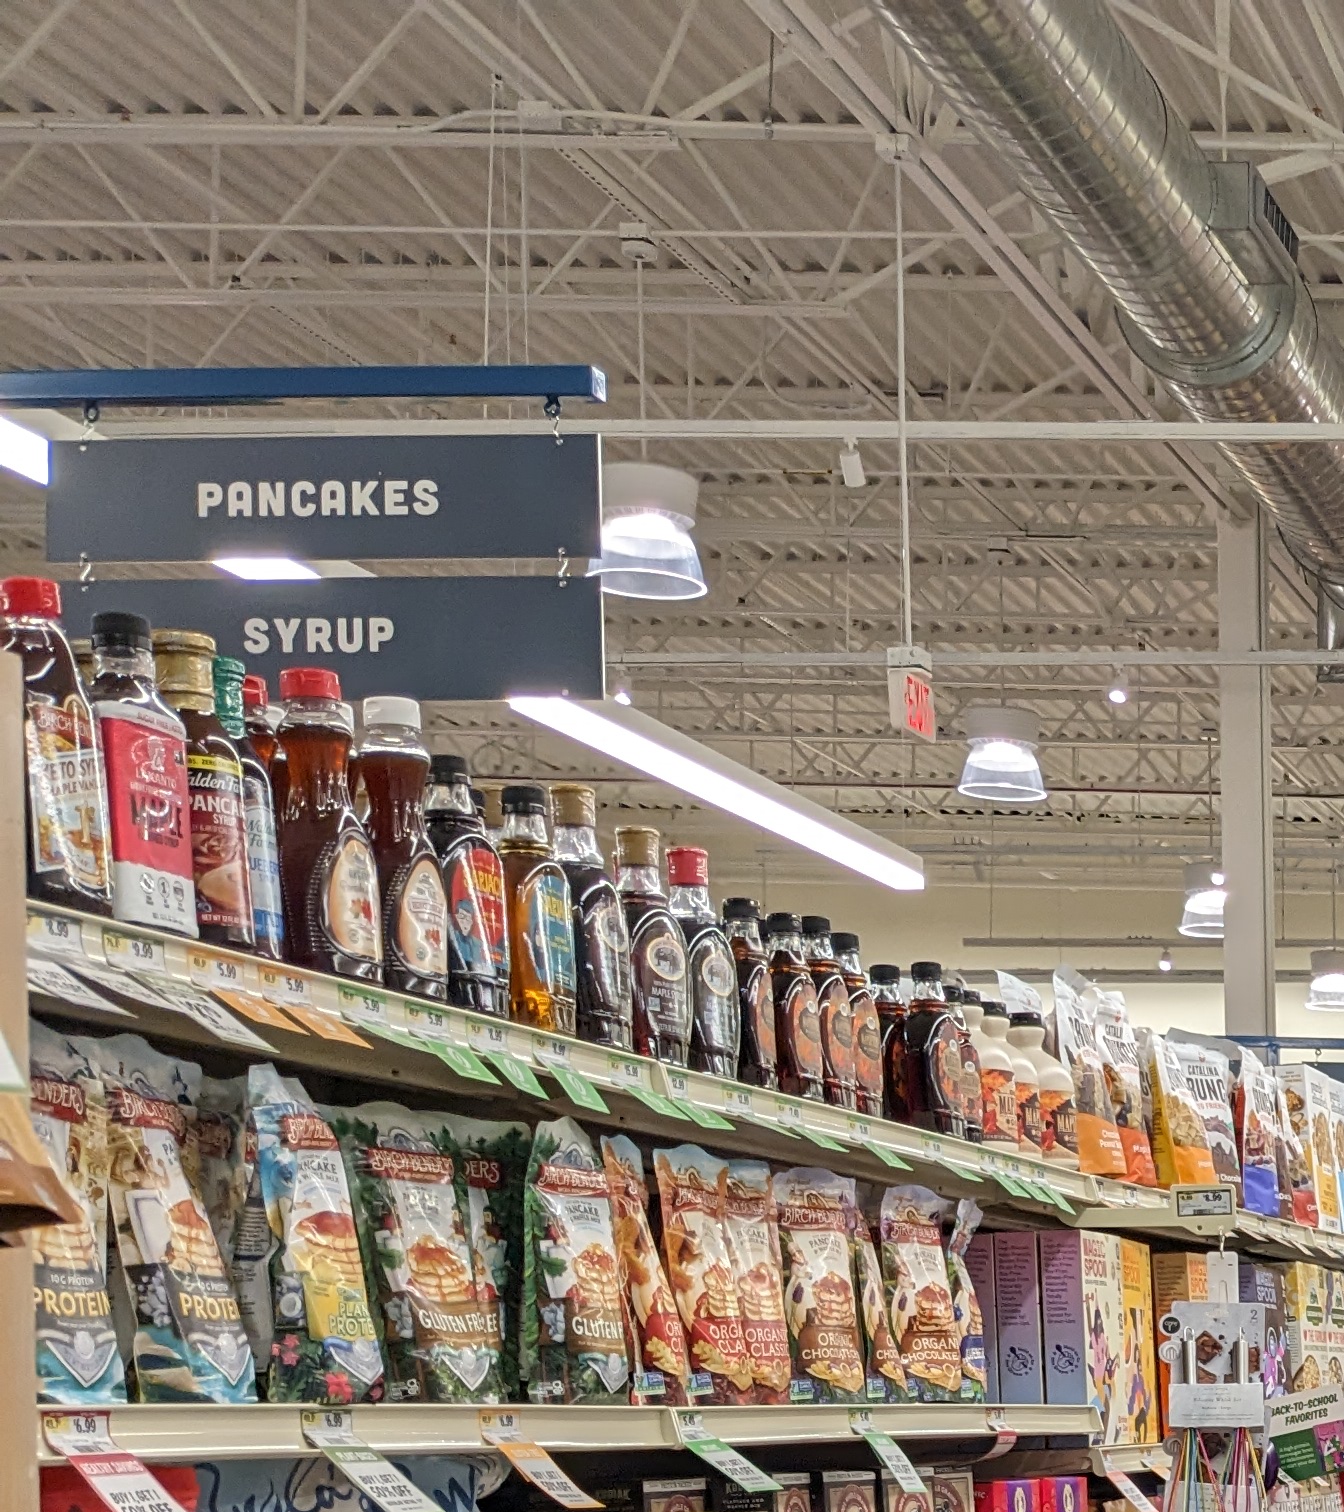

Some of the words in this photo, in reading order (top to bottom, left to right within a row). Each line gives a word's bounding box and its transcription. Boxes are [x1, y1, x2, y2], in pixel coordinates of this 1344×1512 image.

[197, 479, 439, 518] PANCAKES
[243, 617, 396, 654] SYRUP
[418, 1309, 466, 1334] GLUTEN
[1250, 1309, 1258, 1321] 2
[1285, 1407, 1328, 1426] FAVORITES
[110, 1491, 129, 1504] BUY
[136, 1489, 154, 1502] GET
